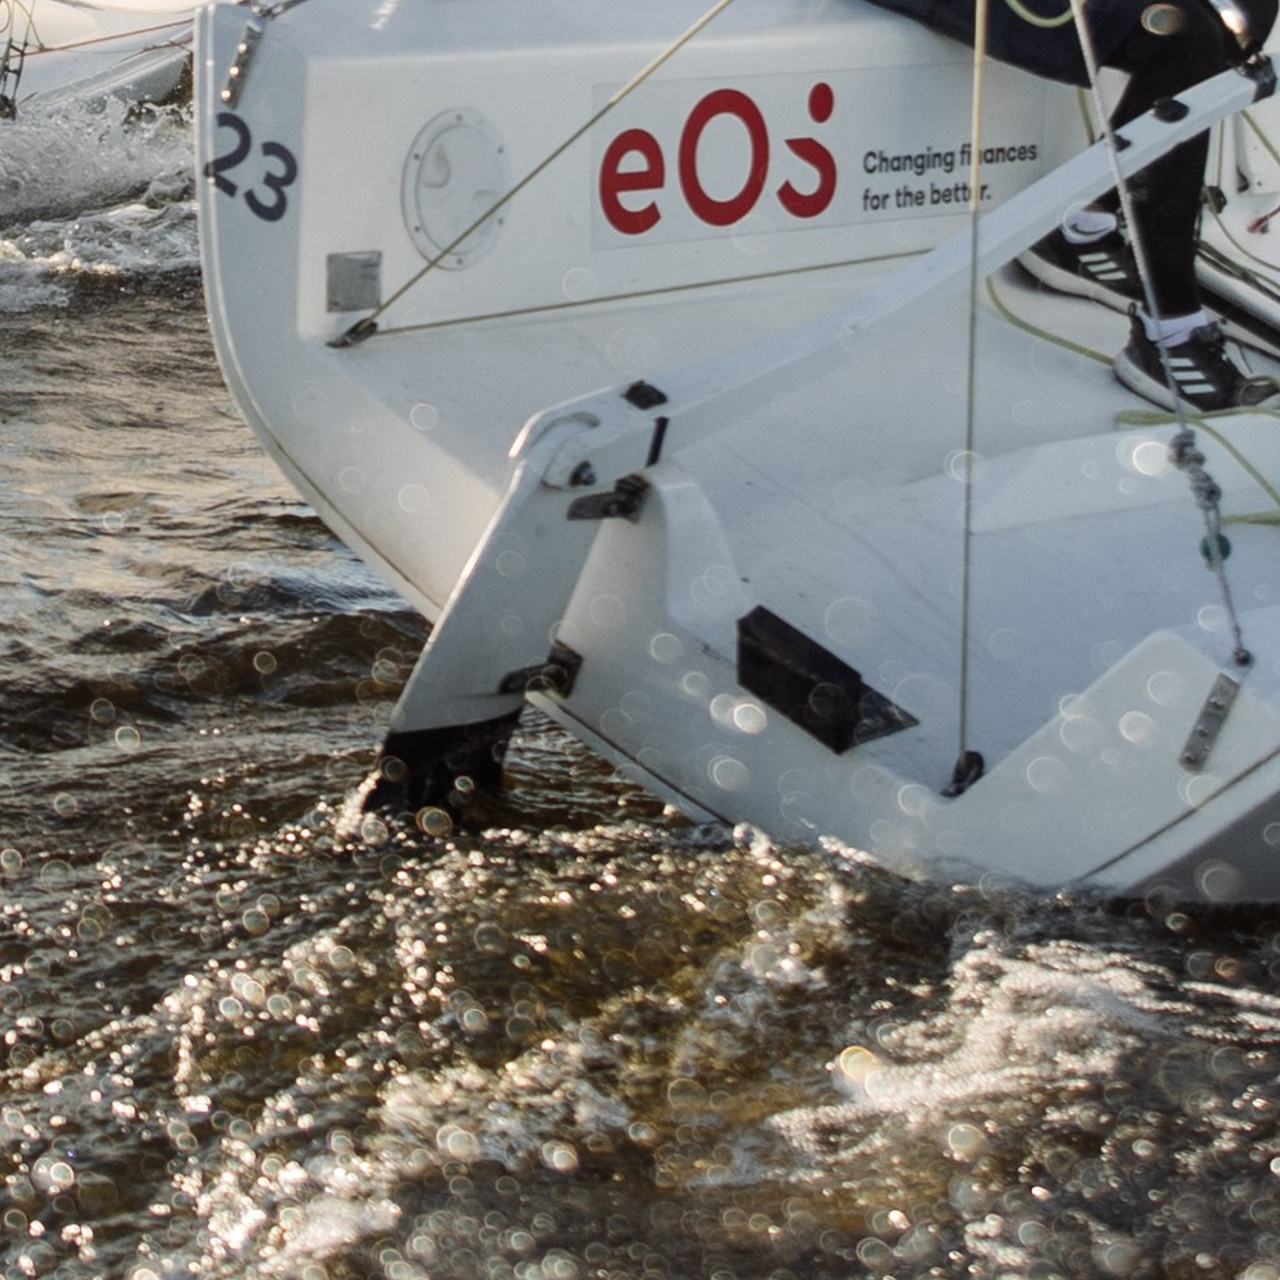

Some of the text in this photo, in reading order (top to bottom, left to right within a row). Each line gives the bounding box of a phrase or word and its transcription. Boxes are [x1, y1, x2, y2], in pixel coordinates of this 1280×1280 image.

[203, 112, 298, 222] 23
[863, 147, 955, 176] Changing
[863, 182, 991, 211] for the bettr.
